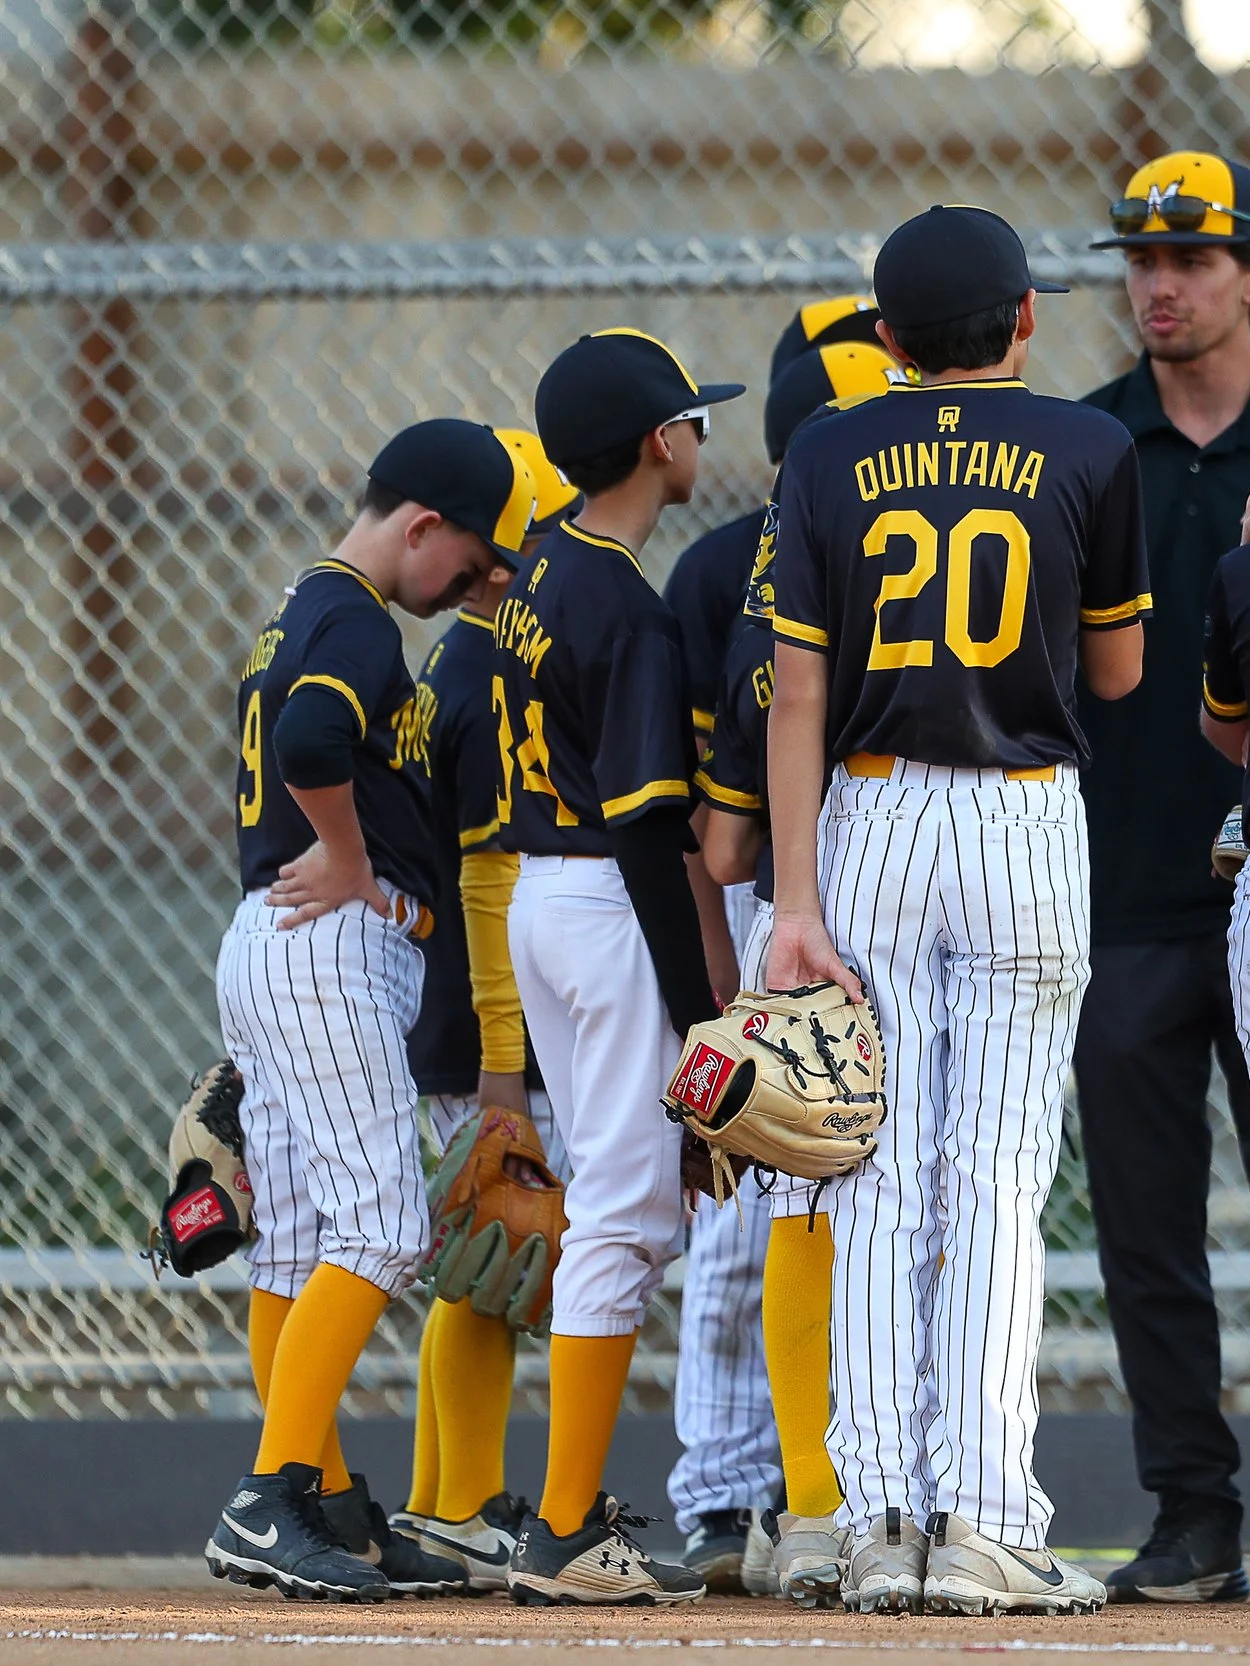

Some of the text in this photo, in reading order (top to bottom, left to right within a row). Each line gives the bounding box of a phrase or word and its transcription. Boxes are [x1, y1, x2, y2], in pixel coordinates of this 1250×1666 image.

[855, 441, 1045, 502] QUINTANA
[862, 508, 1031, 671] 20
[239, 690, 262, 828] 9
[492, 675, 579, 827] 34
[690, 1053, 719, 1103] Rawlings
[822, 1111, 873, 1129] Rawlings
